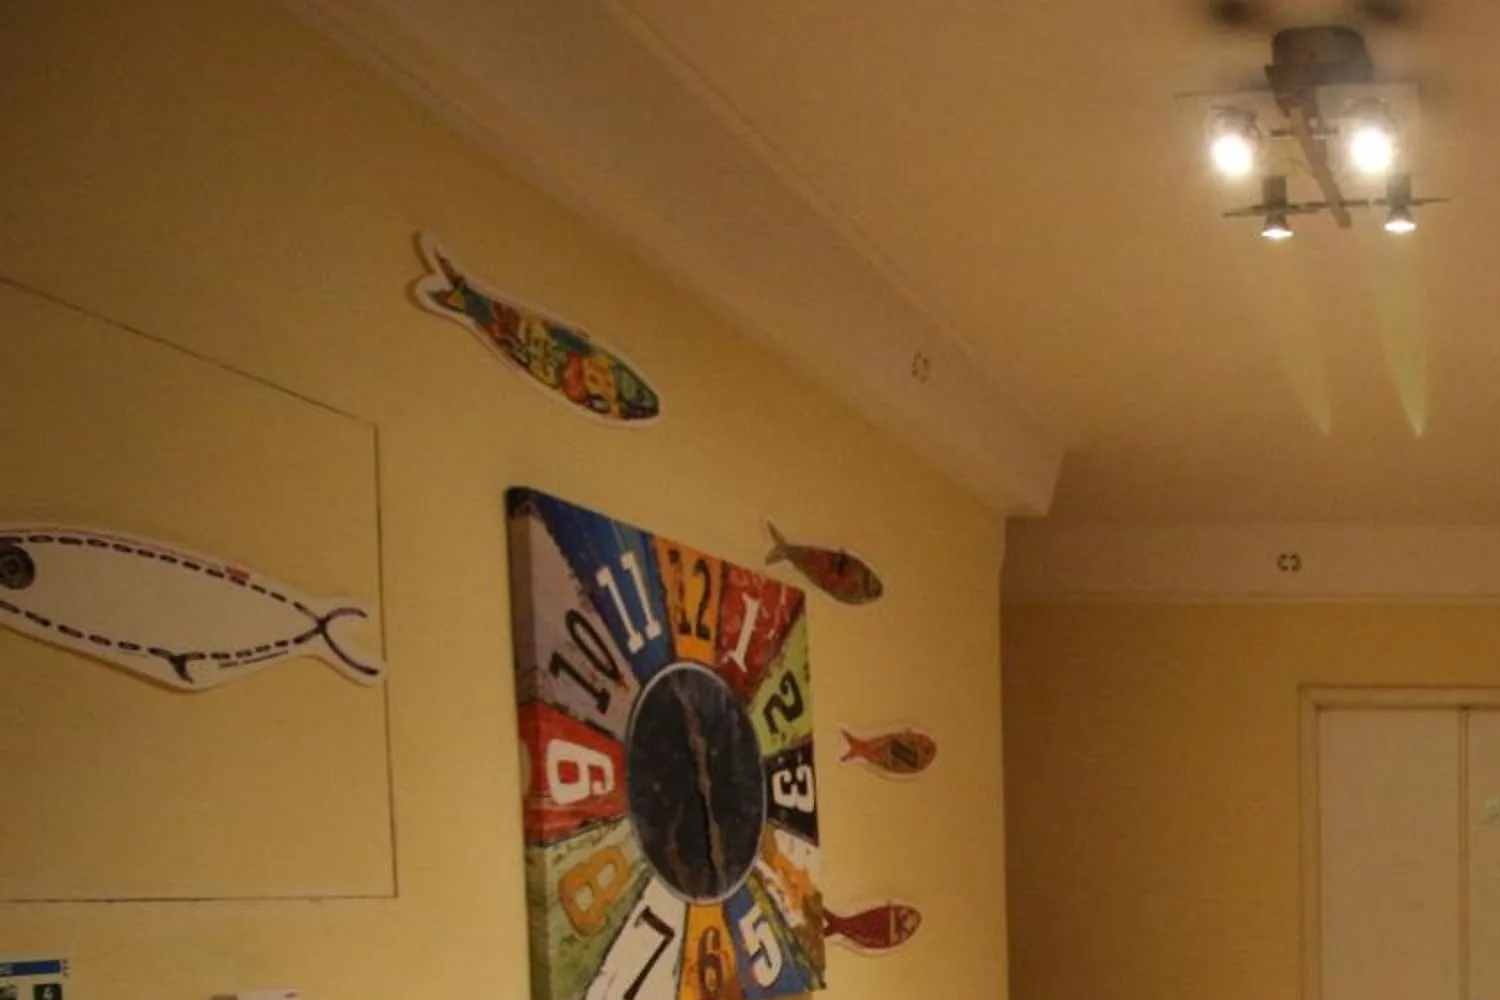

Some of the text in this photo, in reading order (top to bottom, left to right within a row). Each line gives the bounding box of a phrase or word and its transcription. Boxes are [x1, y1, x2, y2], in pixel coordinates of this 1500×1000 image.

[596, 551, 662, 654] 11
[668, 548, 713, 641] 12
[724, 592, 761, 672] 1
[549, 608, 629, 715] 10
[763, 669, 804, 735] 2
[772, 764, 815, 814] 3
[557, 845, 631, 939] 8
[739, 899, 783, 988] 5
